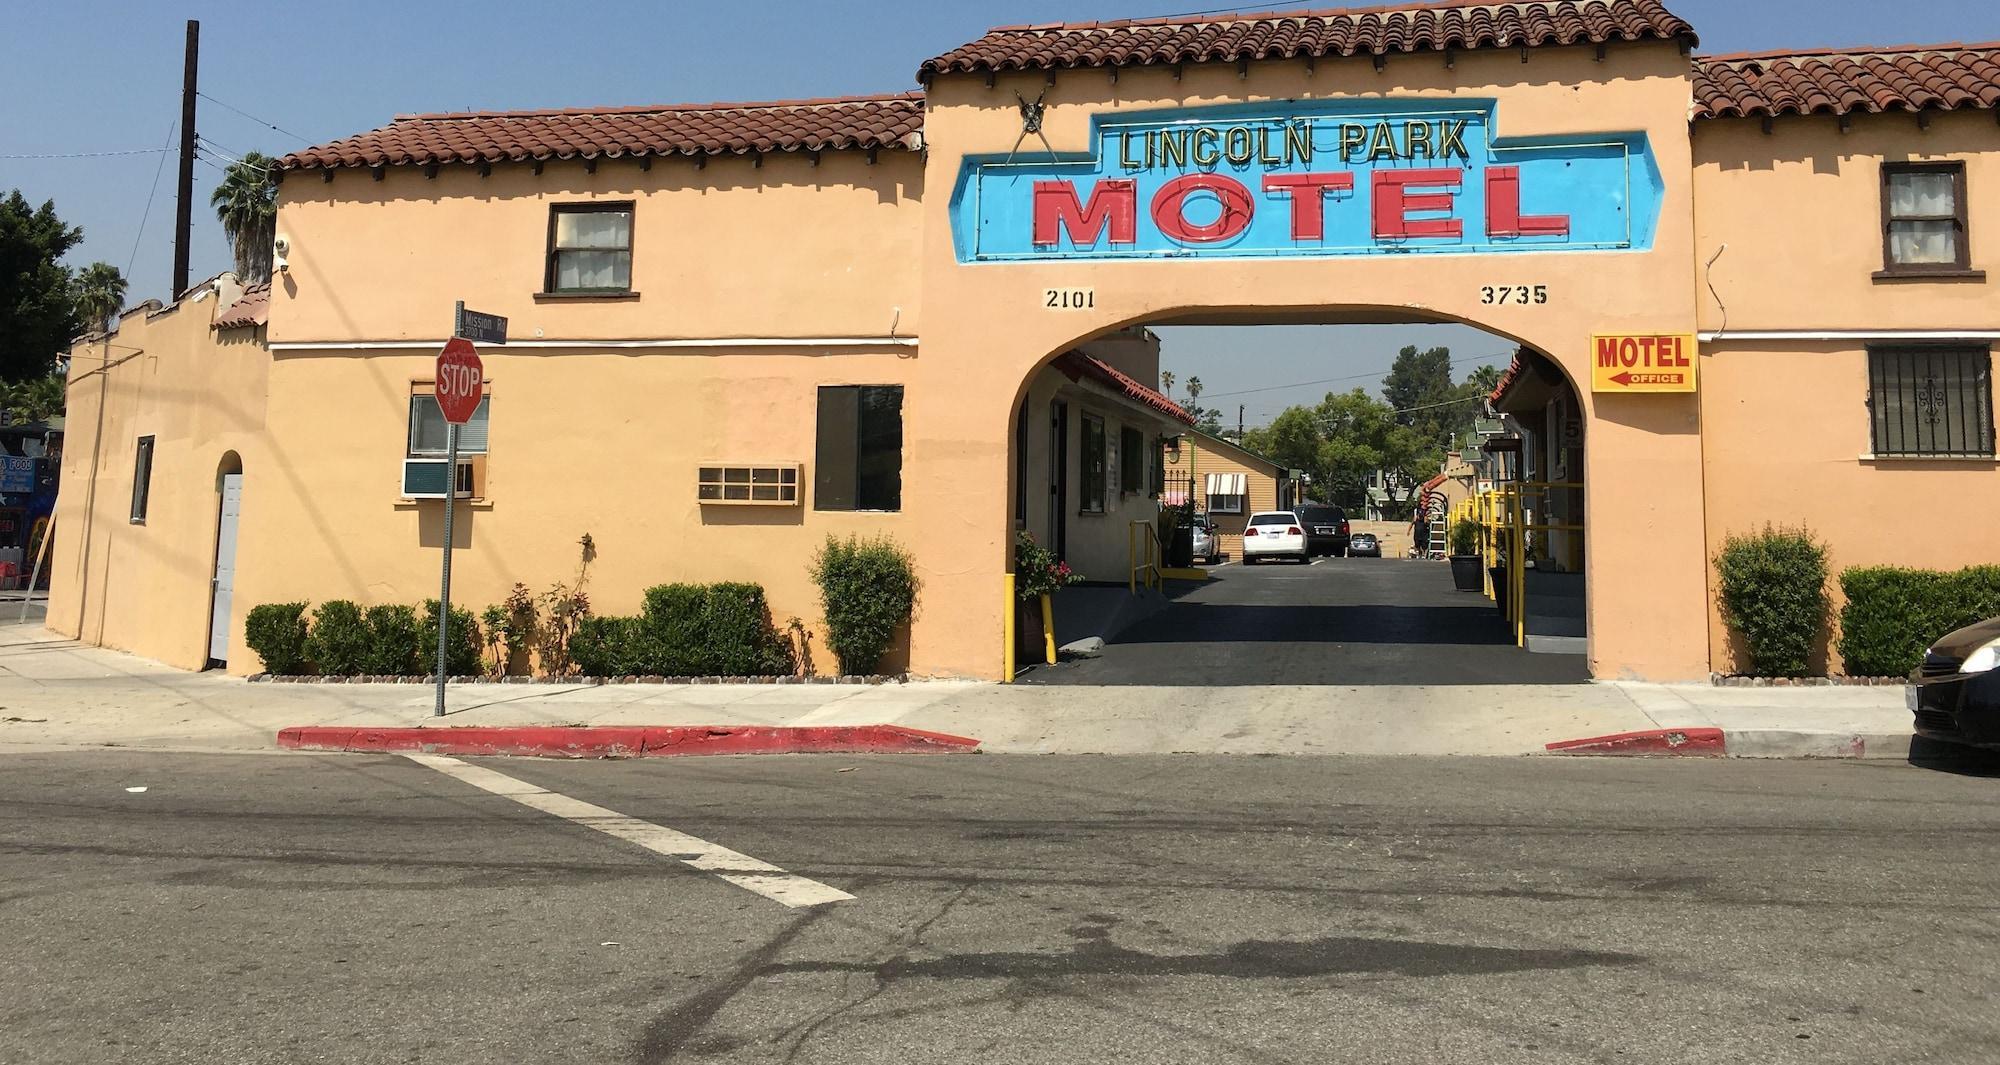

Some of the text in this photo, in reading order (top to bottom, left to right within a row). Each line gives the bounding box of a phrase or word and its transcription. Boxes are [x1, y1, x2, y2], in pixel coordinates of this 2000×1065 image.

[1120, 118, 1469, 168] LINCOLN PARK
[1032, 165, 1570, 246] MOTEL
[1046, 290, 1094, 308] 2101
[1481, 285, 1547, 305] 3735
[465, 311, 506, 333] Mission Rd
[1597, 337, 1690, 367] MOTEL
[440, 363, 480, 397] STOP
[1630, 374, 1679, 383] OFFICE
[9, 458, 33, 471] FOOD
